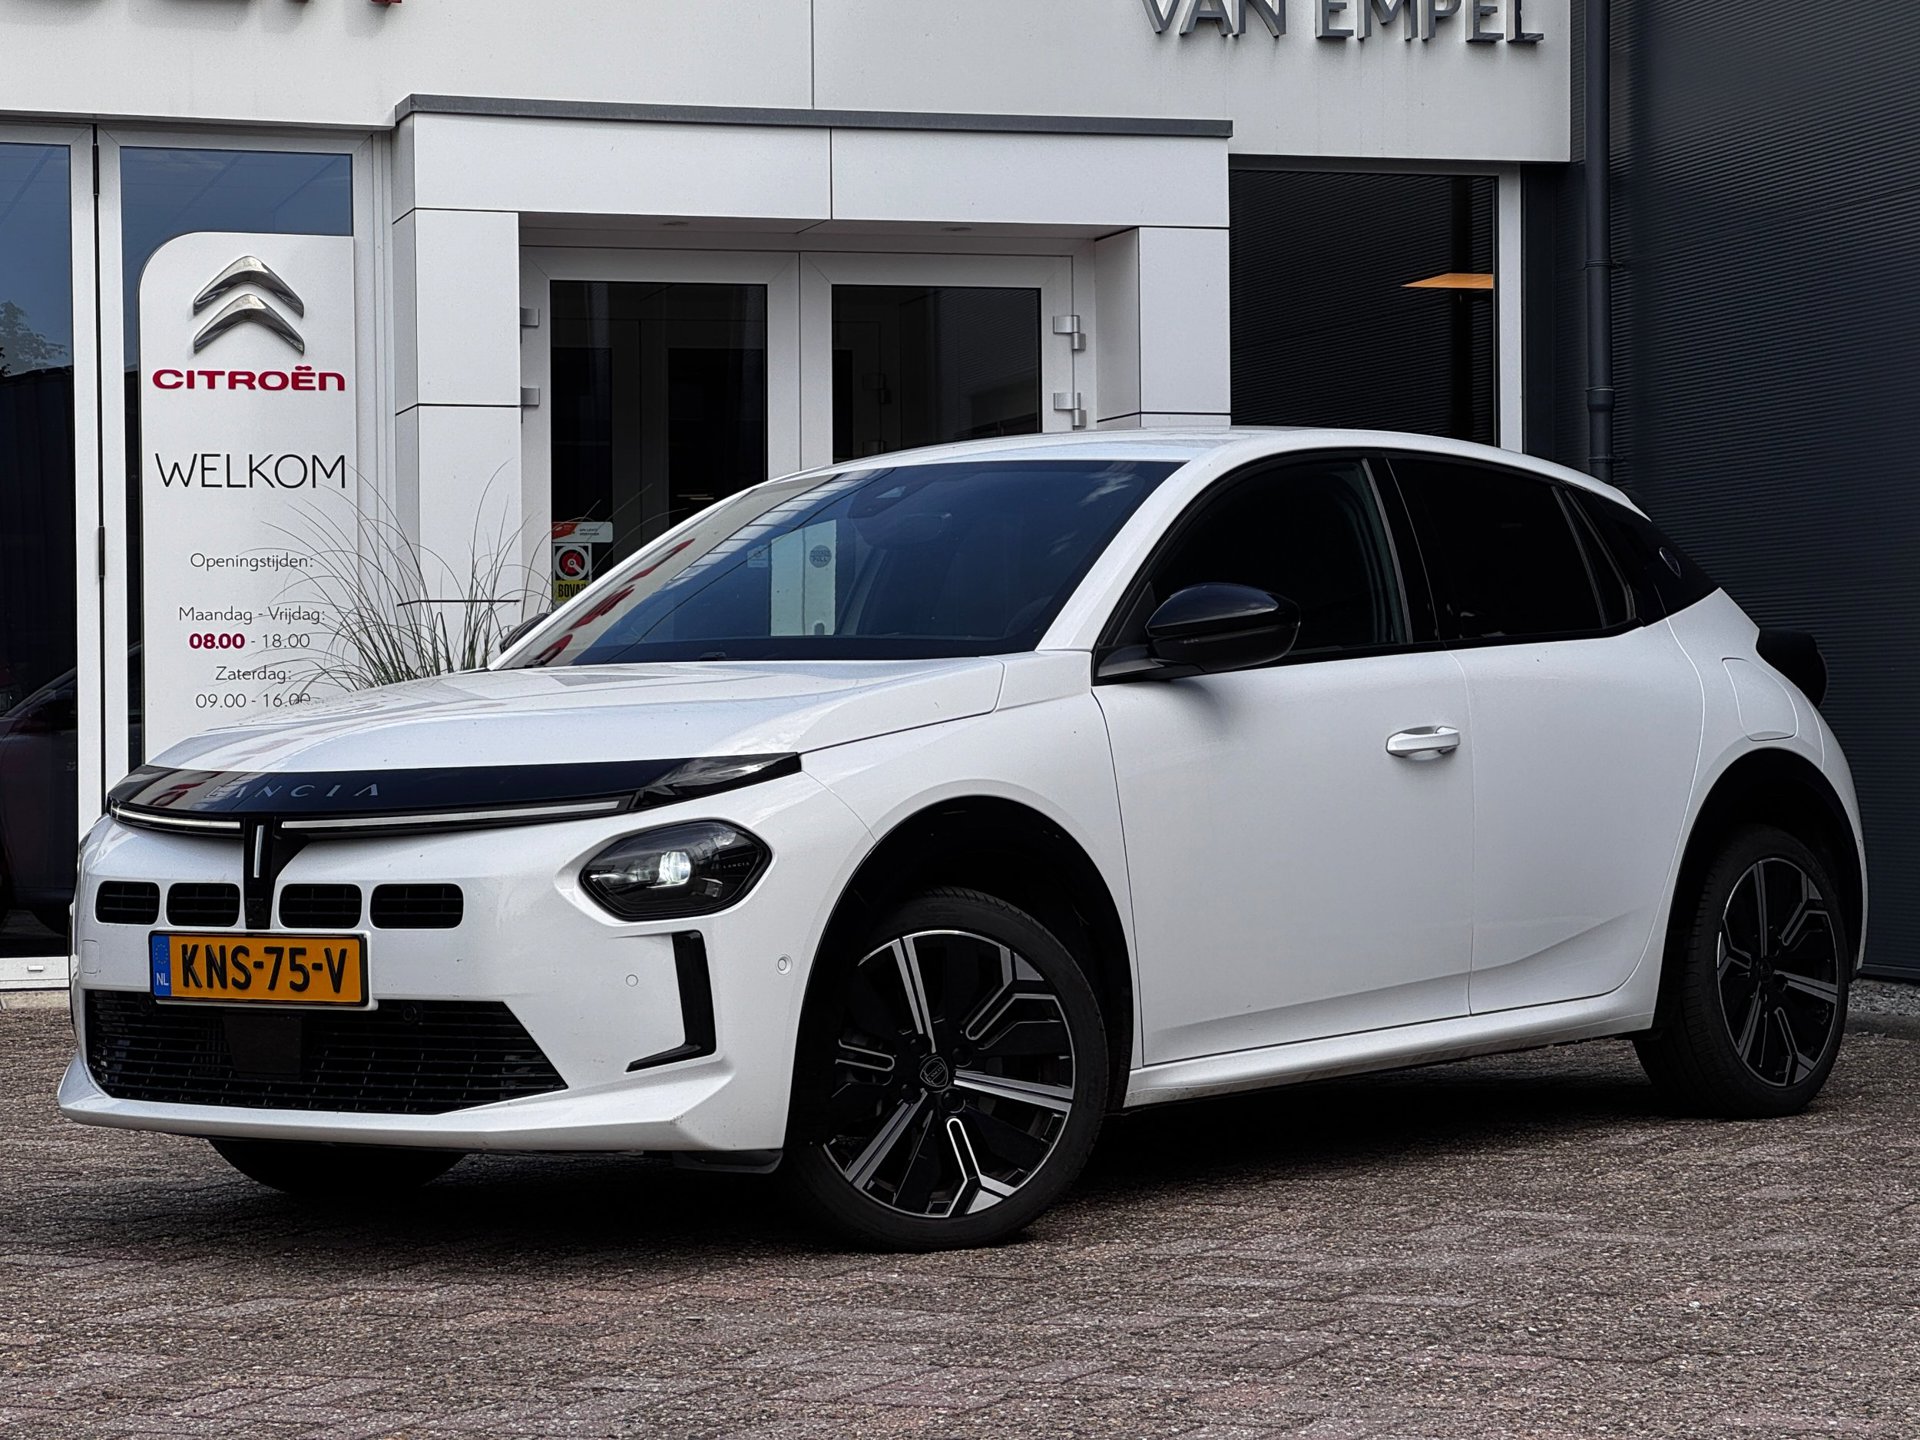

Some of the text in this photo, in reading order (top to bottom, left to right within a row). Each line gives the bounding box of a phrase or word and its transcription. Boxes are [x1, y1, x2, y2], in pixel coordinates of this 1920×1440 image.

[1142, 0, 1544, 43] VAN EMPEL
[155, 453, 346, 489] WELKOM
[190, 552, 314, 572] Openingstijden:
[179, 605, 253, 625] Maandag
[267, 605, 325, 625] Vrijdag:
[189, 633, 246, 649] 08.00
[262, 633, 311, 649] 18.00
[215, 664, 292, 684] Zaterdag:
[195, 693, 247, 709] 09.00
[156, 943, 348, 994] NL KNS-75-V
